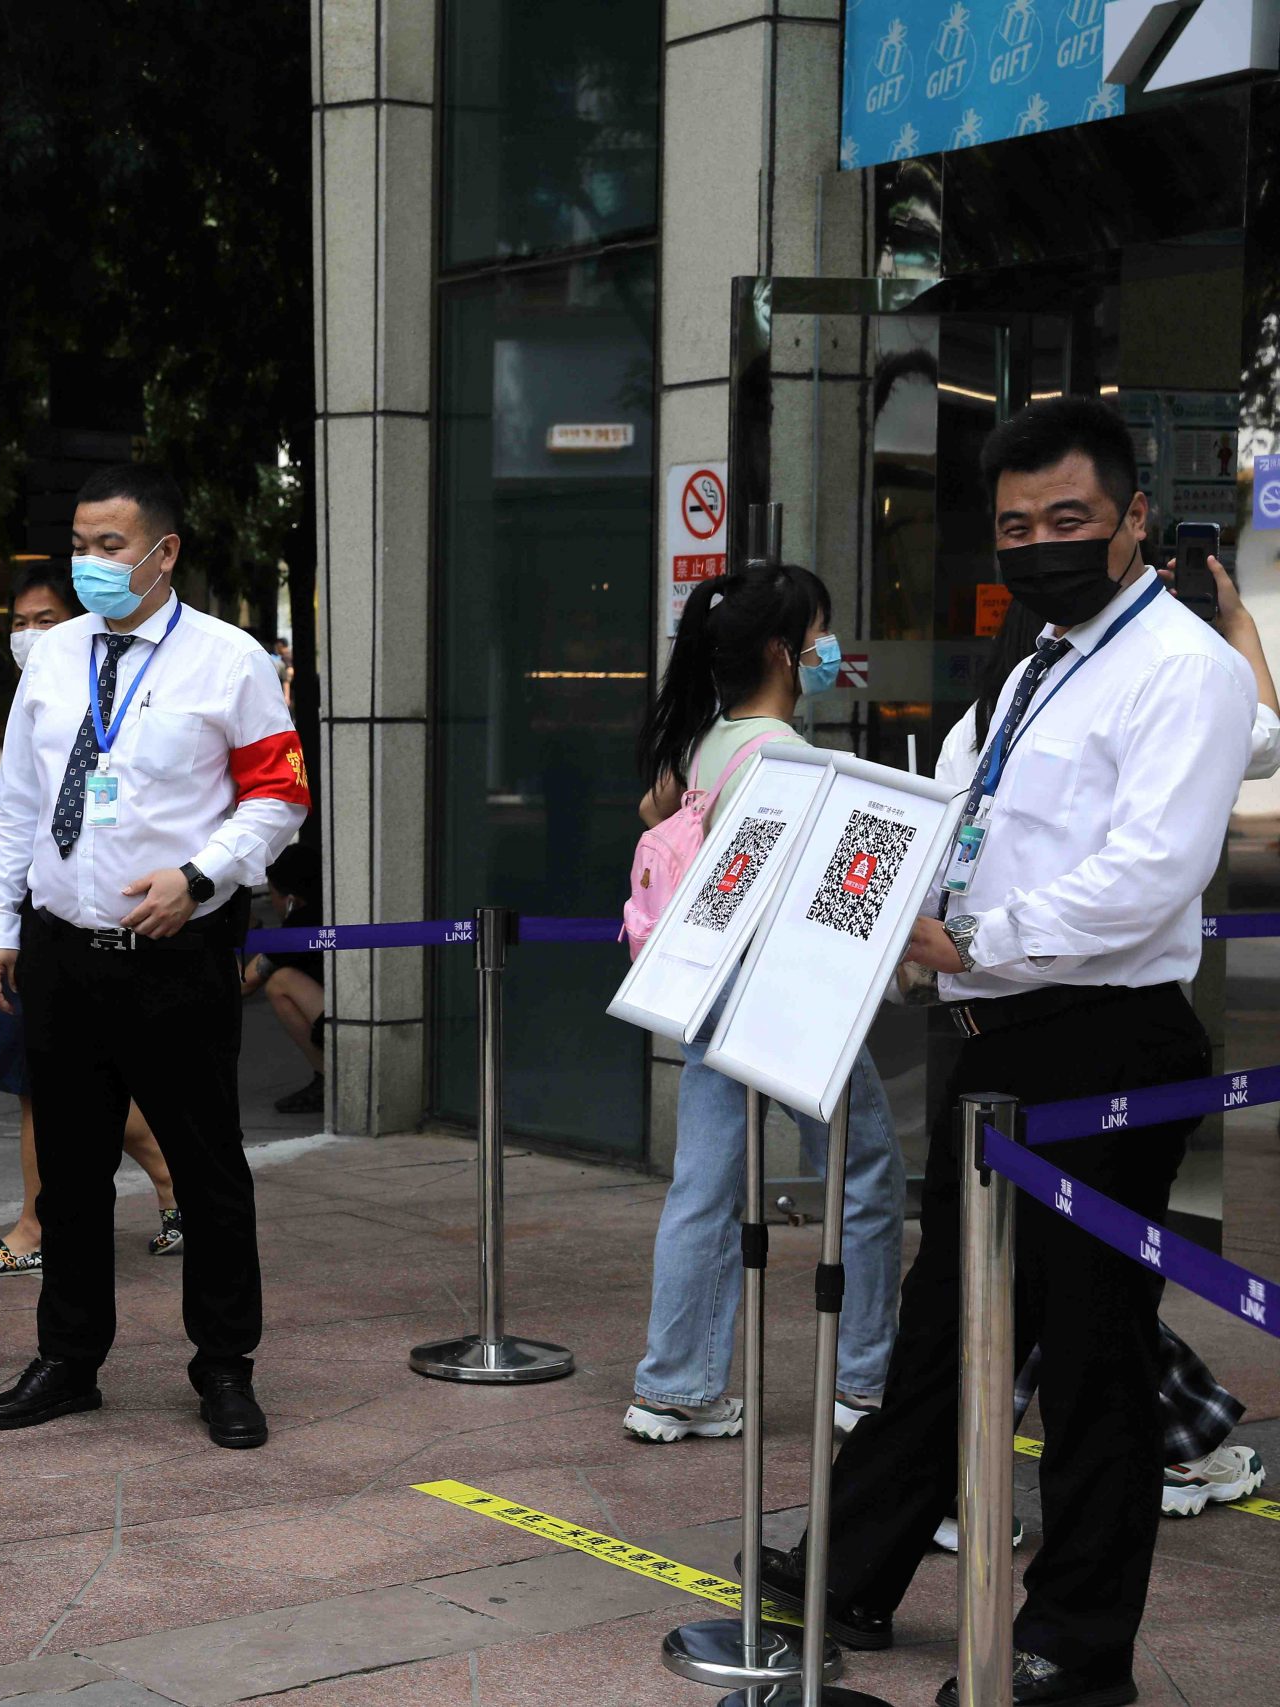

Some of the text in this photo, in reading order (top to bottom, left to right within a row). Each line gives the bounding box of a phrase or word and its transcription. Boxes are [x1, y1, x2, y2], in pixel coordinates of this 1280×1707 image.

[1057, 24, 1102, 69] GIFT
[990, 42, 1033, 85] GIFT
[866, 74, 904, 113] GIFT
[926, 59, 967, 100] GIFT
[672, 583, 687, 596] NO
[309, 939, 336, 949] LINK
[445, 931, 472, 941] LINK
[1223, 1090, 1248, 1106] LINK
[1101, 1111, 1128, 1130] LINK
[1054, 1191, 1072, 1217] LINK
[1140, 1240, 1161, 1268] LINK
[1240, 1294, 1266, 1325] LINK
[490, 1510, 518, 1521] Please
[570, 1538, 584, 1546] The
[583, 1544, 603, 1553] One
[685, 1583, 703, 1591] For
[500, 1506, 786, 1613] 请在一米线外等候，谢谢
